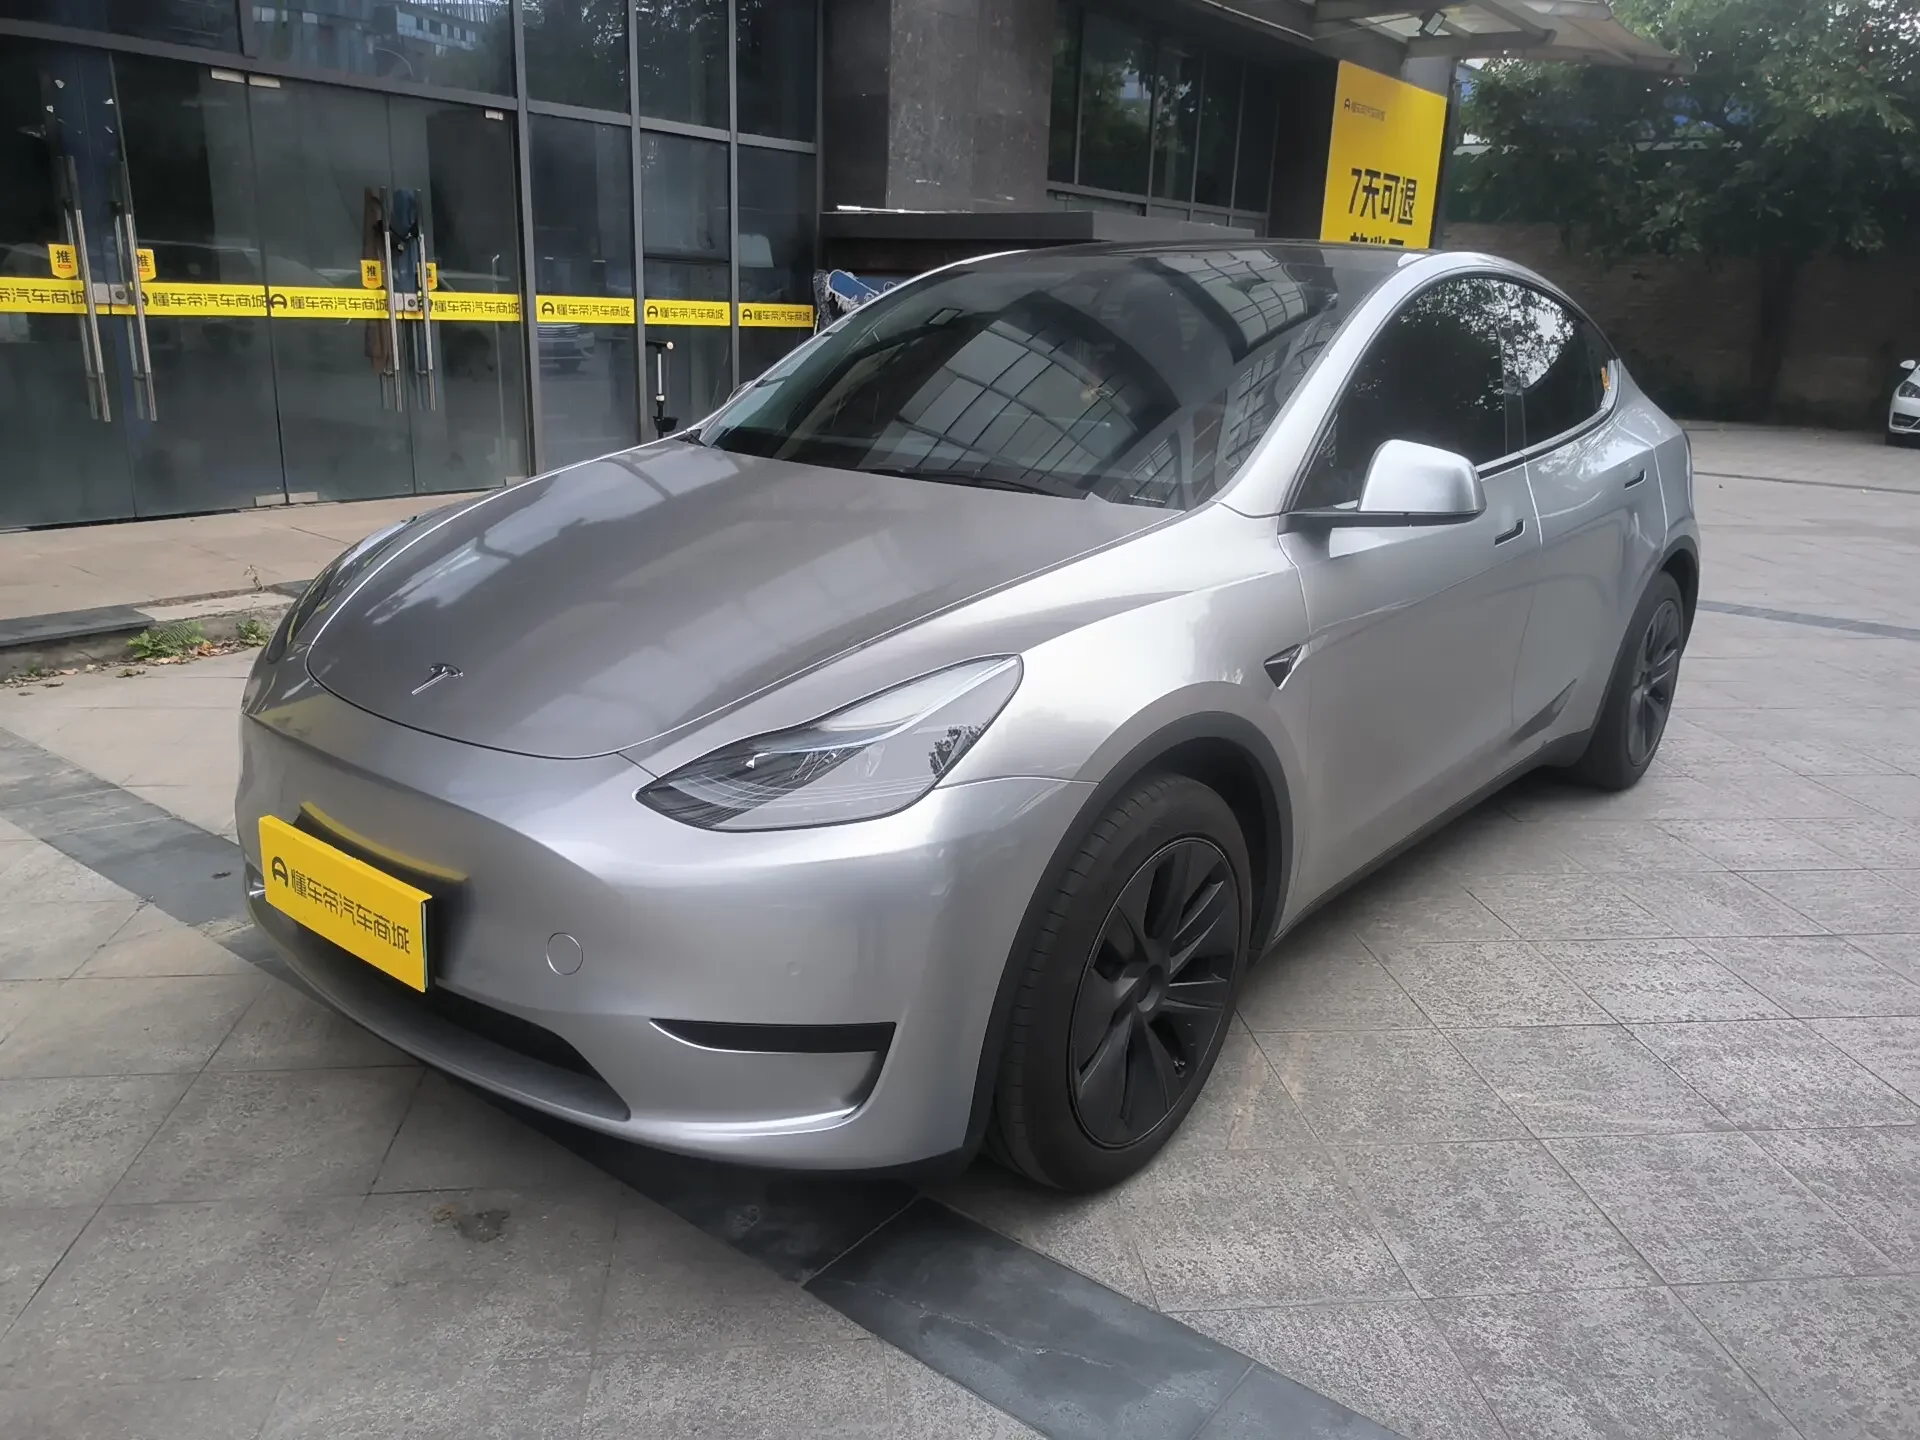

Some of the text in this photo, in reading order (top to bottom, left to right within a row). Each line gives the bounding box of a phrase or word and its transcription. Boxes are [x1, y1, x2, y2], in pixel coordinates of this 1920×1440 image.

[1349, 168, 1417, 225] 7天可退
[56, 250, 71, 264] 推
[366, 265, 377, 277] 推
[152, 292, 267, 308] 懂车帝汽车商城
[290, 295, 389, 311] 懂车帝汽车商城
[434, 300, 520, 315] 懂车帝汽车商城
[557, 304, 631, 317] 懂车帝汽车商城
[660, 307, 724, 320] 懂车帝汽车商城
[754, 310, 811, 323] 懂车帝汽车商城
[291, 868, 411, 954] 懂车帝汽车商城
